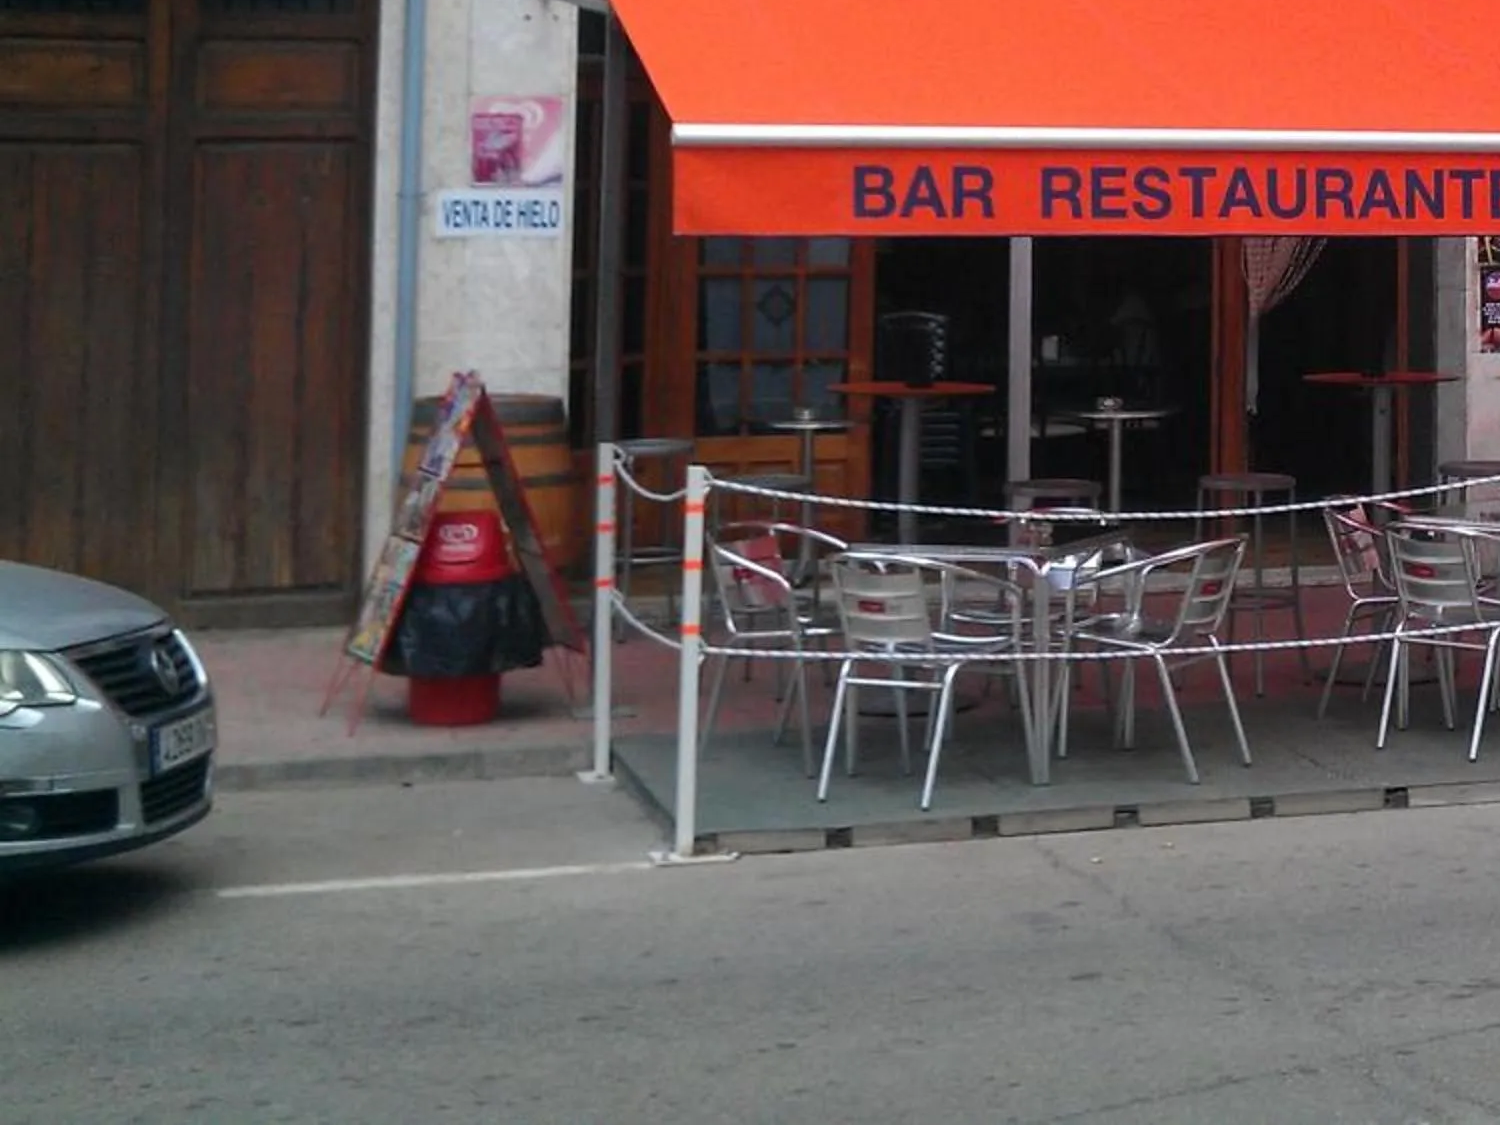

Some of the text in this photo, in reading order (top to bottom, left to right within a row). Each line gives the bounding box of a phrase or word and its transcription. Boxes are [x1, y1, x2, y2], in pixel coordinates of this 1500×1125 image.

[851, 164, 995, 220] BAR
[442, 199, 560, 228] VENTA DE HIELO
